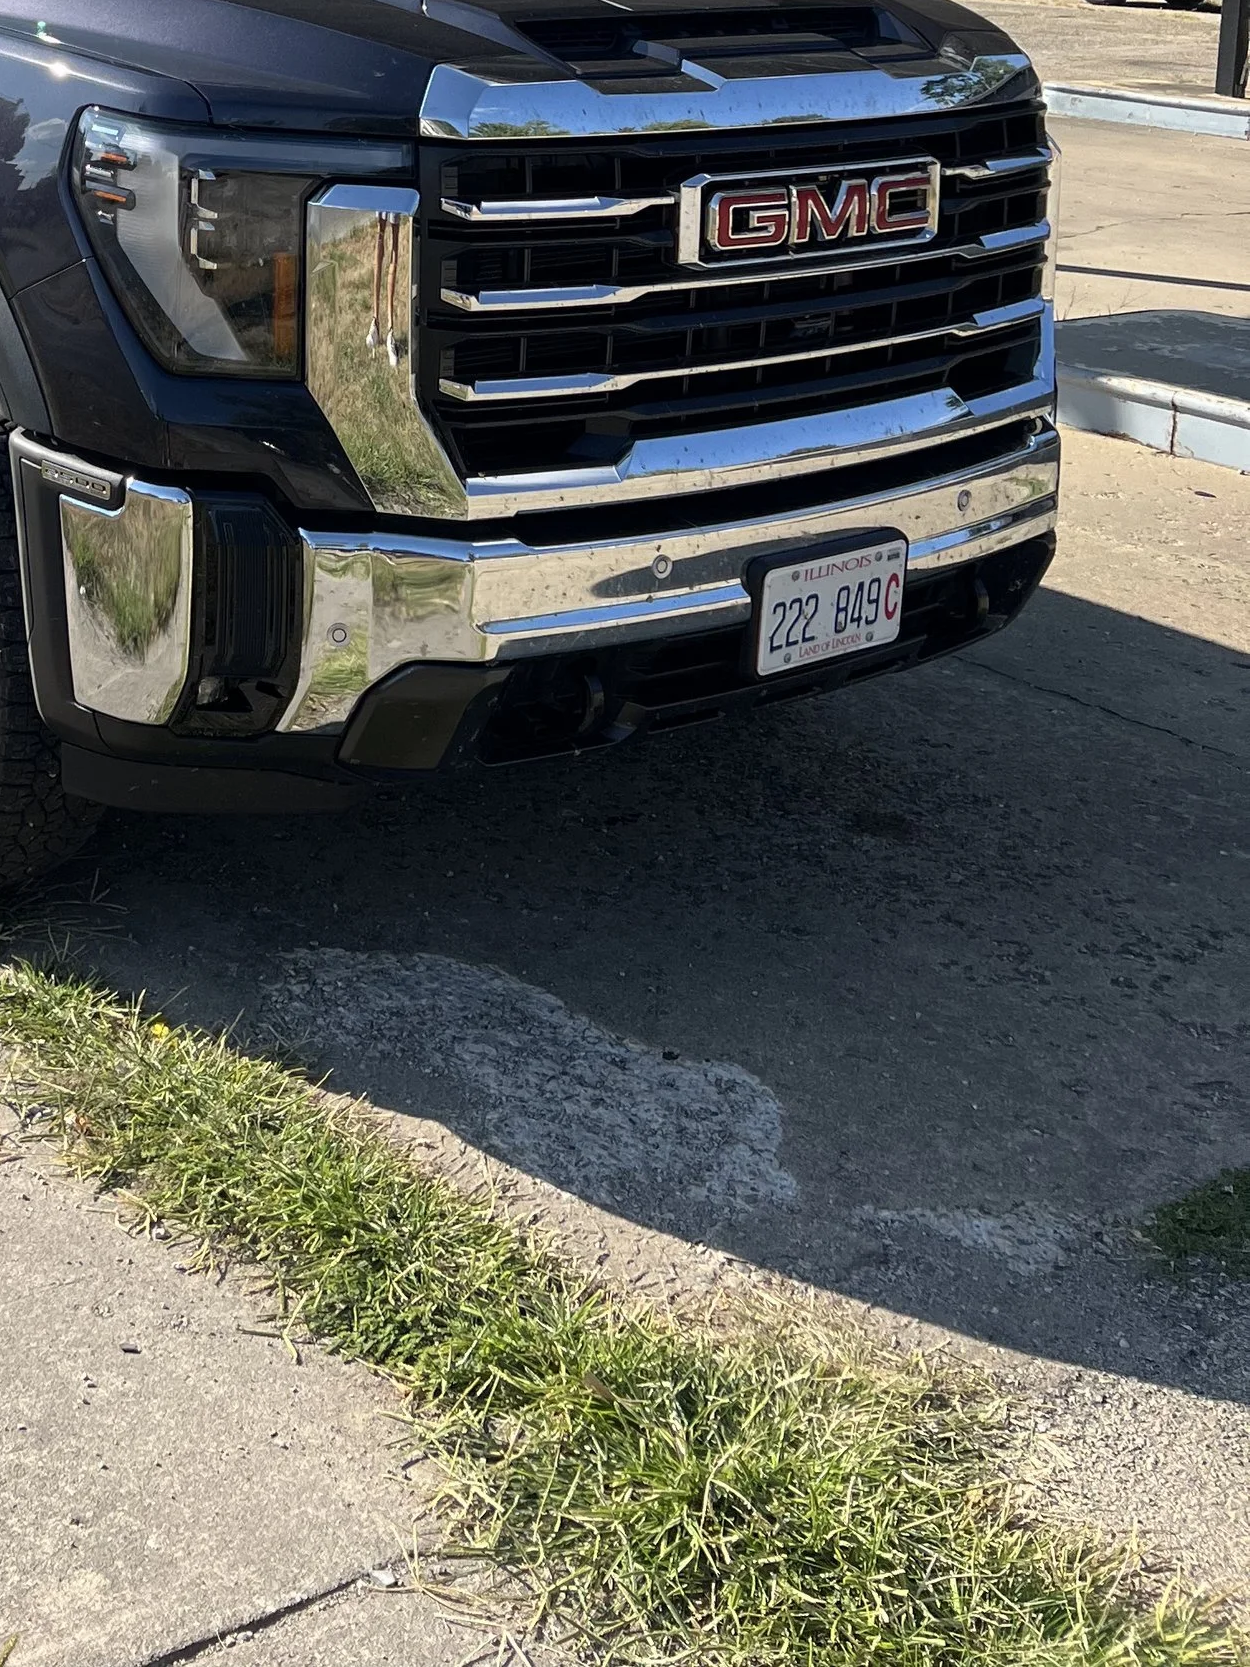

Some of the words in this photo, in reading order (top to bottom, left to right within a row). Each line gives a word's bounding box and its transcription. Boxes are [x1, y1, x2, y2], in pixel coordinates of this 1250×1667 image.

[705, 172, 931, 251] GMC
[44, 467, 108, 495] 2500
[803, 554, 872, 582] ILLINOIS
[769, 593, 820, 653] 222
[799, 642, 820, 658] LAND
[821, 640, 831, 652] OF
[831, 633, 862, 649] LINCOLN
